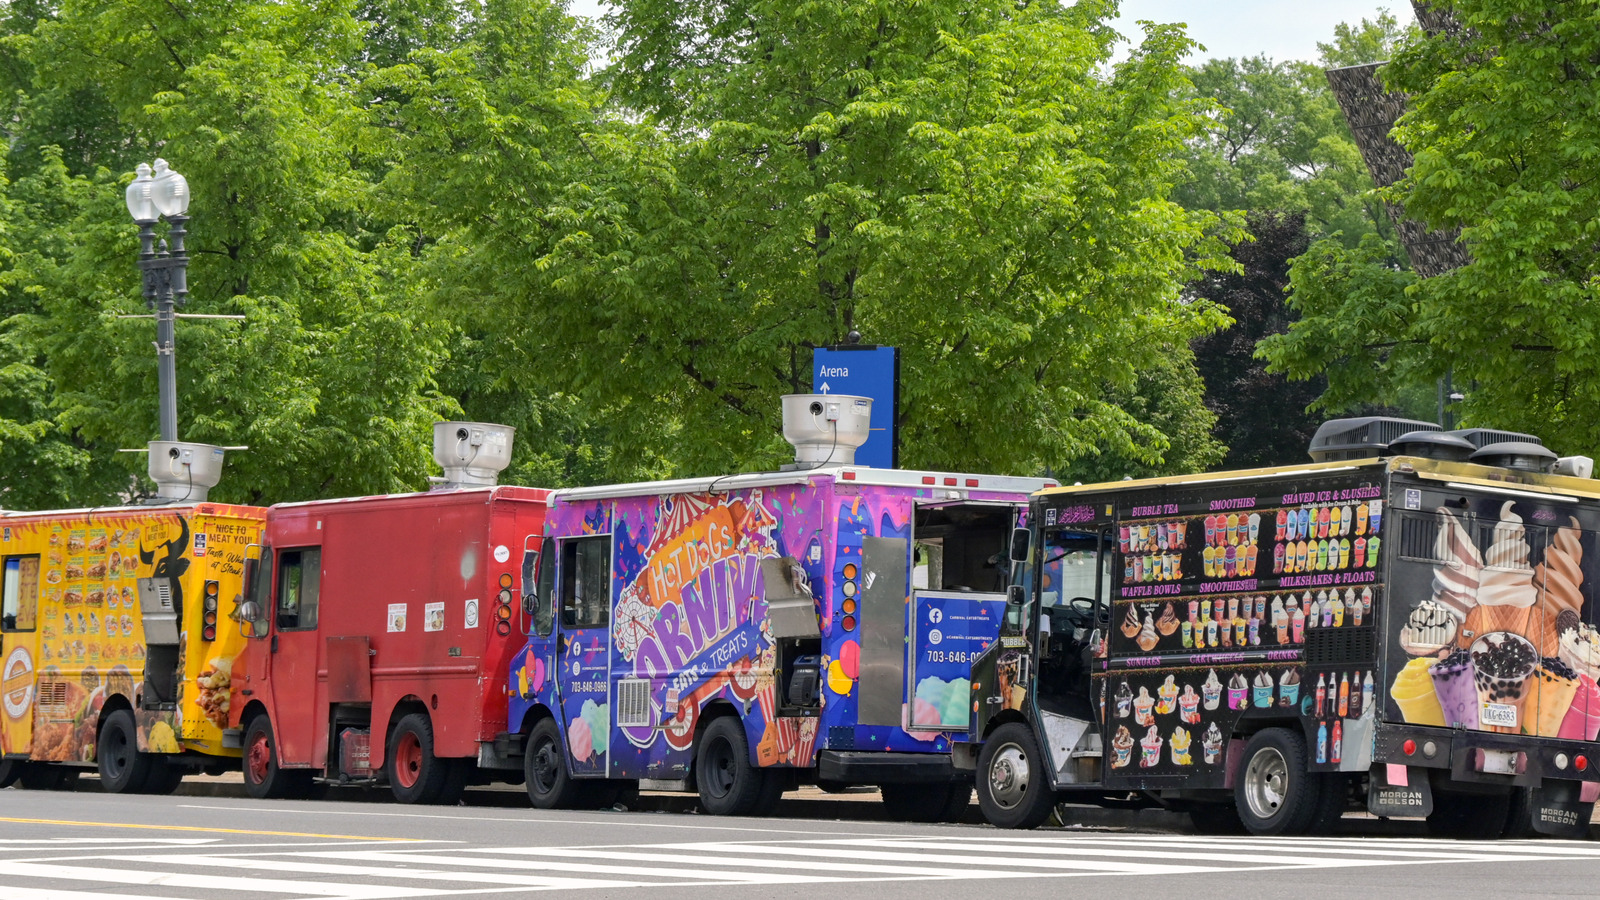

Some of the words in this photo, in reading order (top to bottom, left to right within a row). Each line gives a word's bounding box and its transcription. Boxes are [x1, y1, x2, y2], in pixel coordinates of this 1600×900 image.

[820, 364, 848, 377] Arena
[1282, 492, 1314, 504] SHAVED
[1317, 490, 1331, 501] ICE
[1332, 490, 1339, 500] &
[1341, 487, 1380, 500] SLUSHIES
[1132, 505, 1162, 516] BUBBLE
[1164, 504, 1178, 514] TEA
[1209, 497, 1256, 510] SMOOTHIES
[216, 524, 234, 534] NICE
[236, 526, 246, 534] TO
[209, 534, 231, 543] MEAT
[234, 536, 252, 544] YOU!
[207, 547, 223, 558] Taste
[211, 562, 220, 571] at
[221, 563, 243, 578] Steak!
[1280, 574, 1333, 587] MILKSHAKES
[1334, 573, 1341, 583] &
[1343, 571, 1375, 583] FLOATS
[1121, 585, 1152, 597] WAFFLE
[1154, 584, 1181, 595] BOWLS
[1199, 580, 1245, 593] SMOOTHIES
[1126, 656, 1161, 667] SUNDAES
[1267, 650, 1298, 660] DRINKS
[673, 665, 699, 694] EATS
[700, 662, 708, 675] &
[710, 631, 748, 668] TREATS
[1541, 808, 1578, 819] MORGAN
